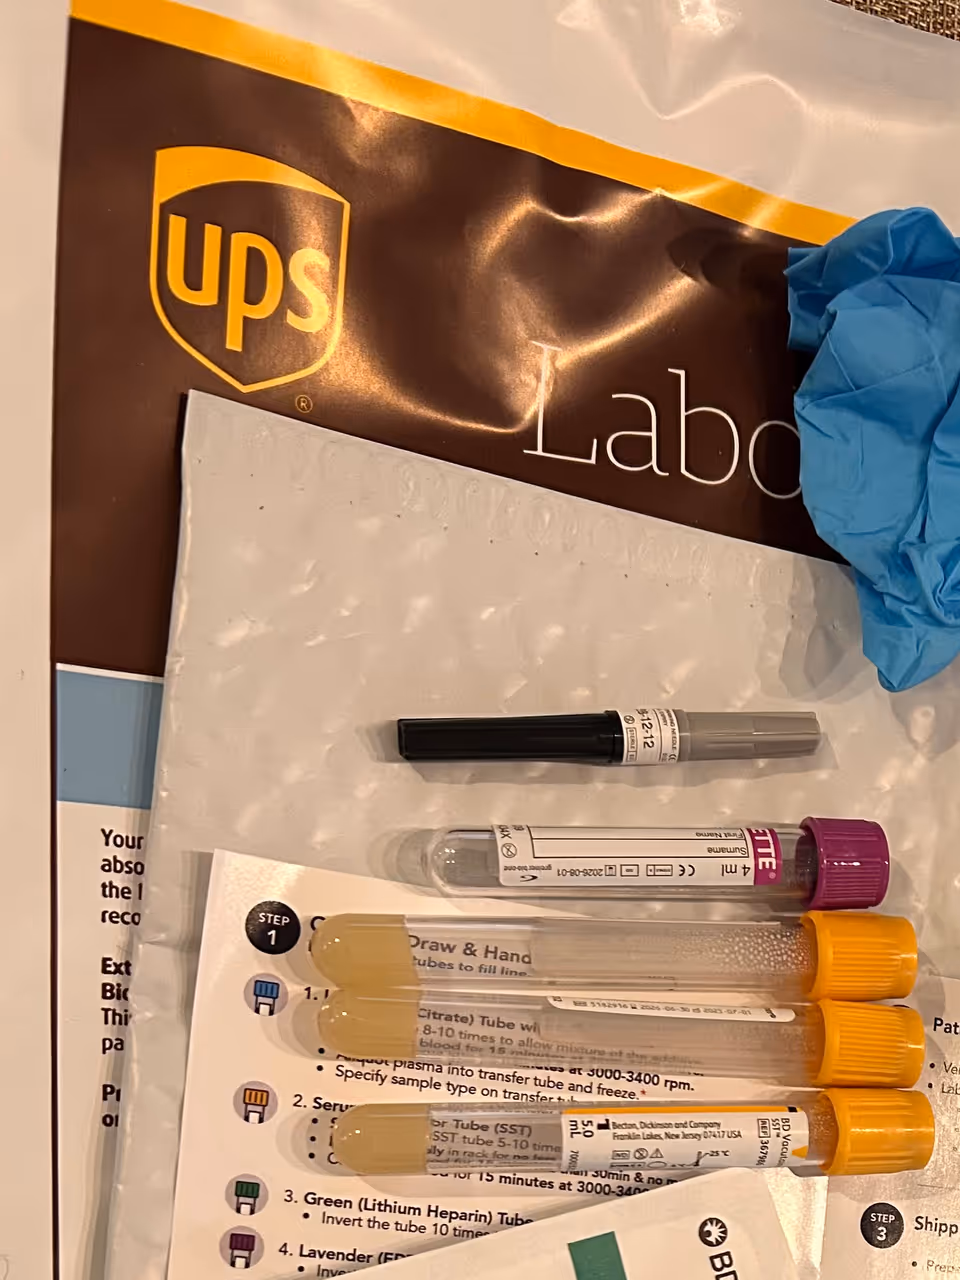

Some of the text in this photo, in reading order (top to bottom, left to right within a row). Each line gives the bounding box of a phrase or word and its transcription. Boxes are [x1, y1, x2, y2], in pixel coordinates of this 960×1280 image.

[166, 213, 331, 353] ups
[99, 827, 144, 850] Your
[720, 863, 737, 876] ml
[100, 879, 132, 900] the
[257, 911, 290, 926] STEP
[266, 929, 276, 945] 1
[457, 961, 474, 972] to
[334, 1063, 477, 1097] Specify sample type
[477, 1068, 564, 1090] transfer tube
[663, 1078, 694, 1092] rpm.
[452, 1118, 532, 1138] Tube (SST)
[498, 1172, 554, 1189] minutes
[283, 1188, 493, 1227] 3. Green (Lithium Heparin)
[869, 1212, 895, 1223] STEP
[321, 1210, 427, 1234] Invert the tube
[277, 1241, 374, 1264] 4. Lavender
